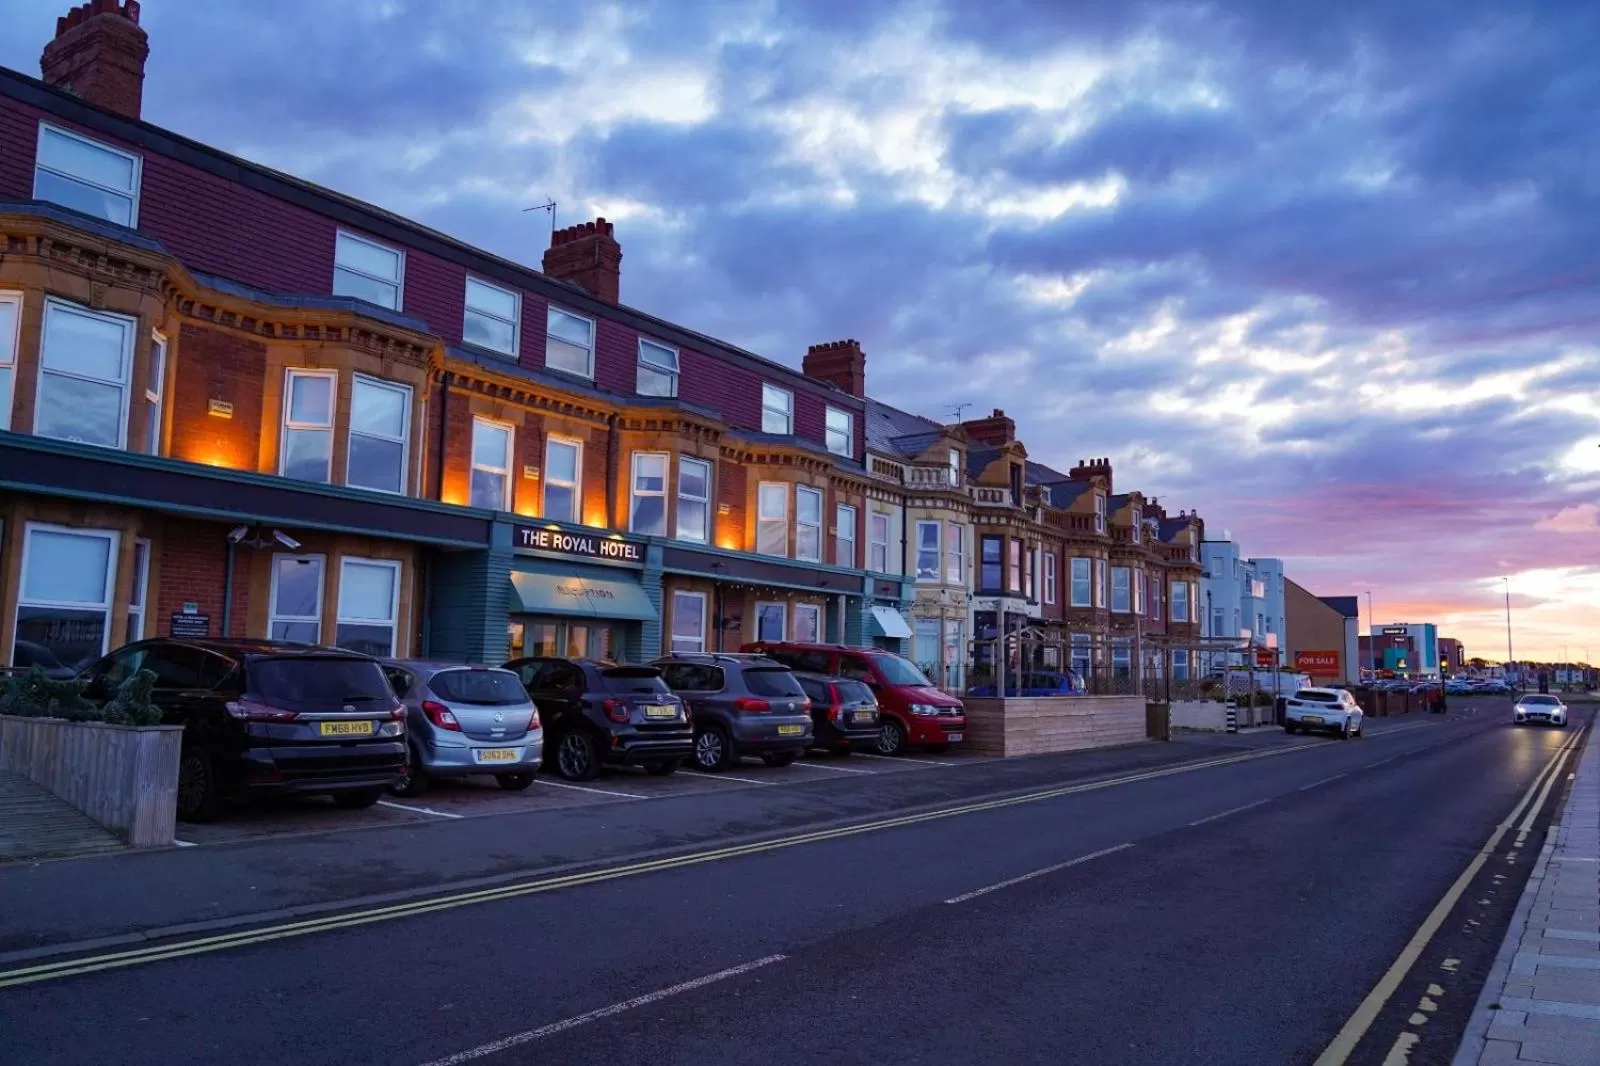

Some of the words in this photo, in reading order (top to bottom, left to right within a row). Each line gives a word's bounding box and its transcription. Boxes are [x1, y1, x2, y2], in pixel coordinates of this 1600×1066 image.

[521, 530, 549, 546] THE
[553, 534, 596, 553] ROYAL
[600, 541, 639, 559] HOTEL
[1299, 657, 1314, 665] FOR
[1316, 656, 1334, 665] SALE
